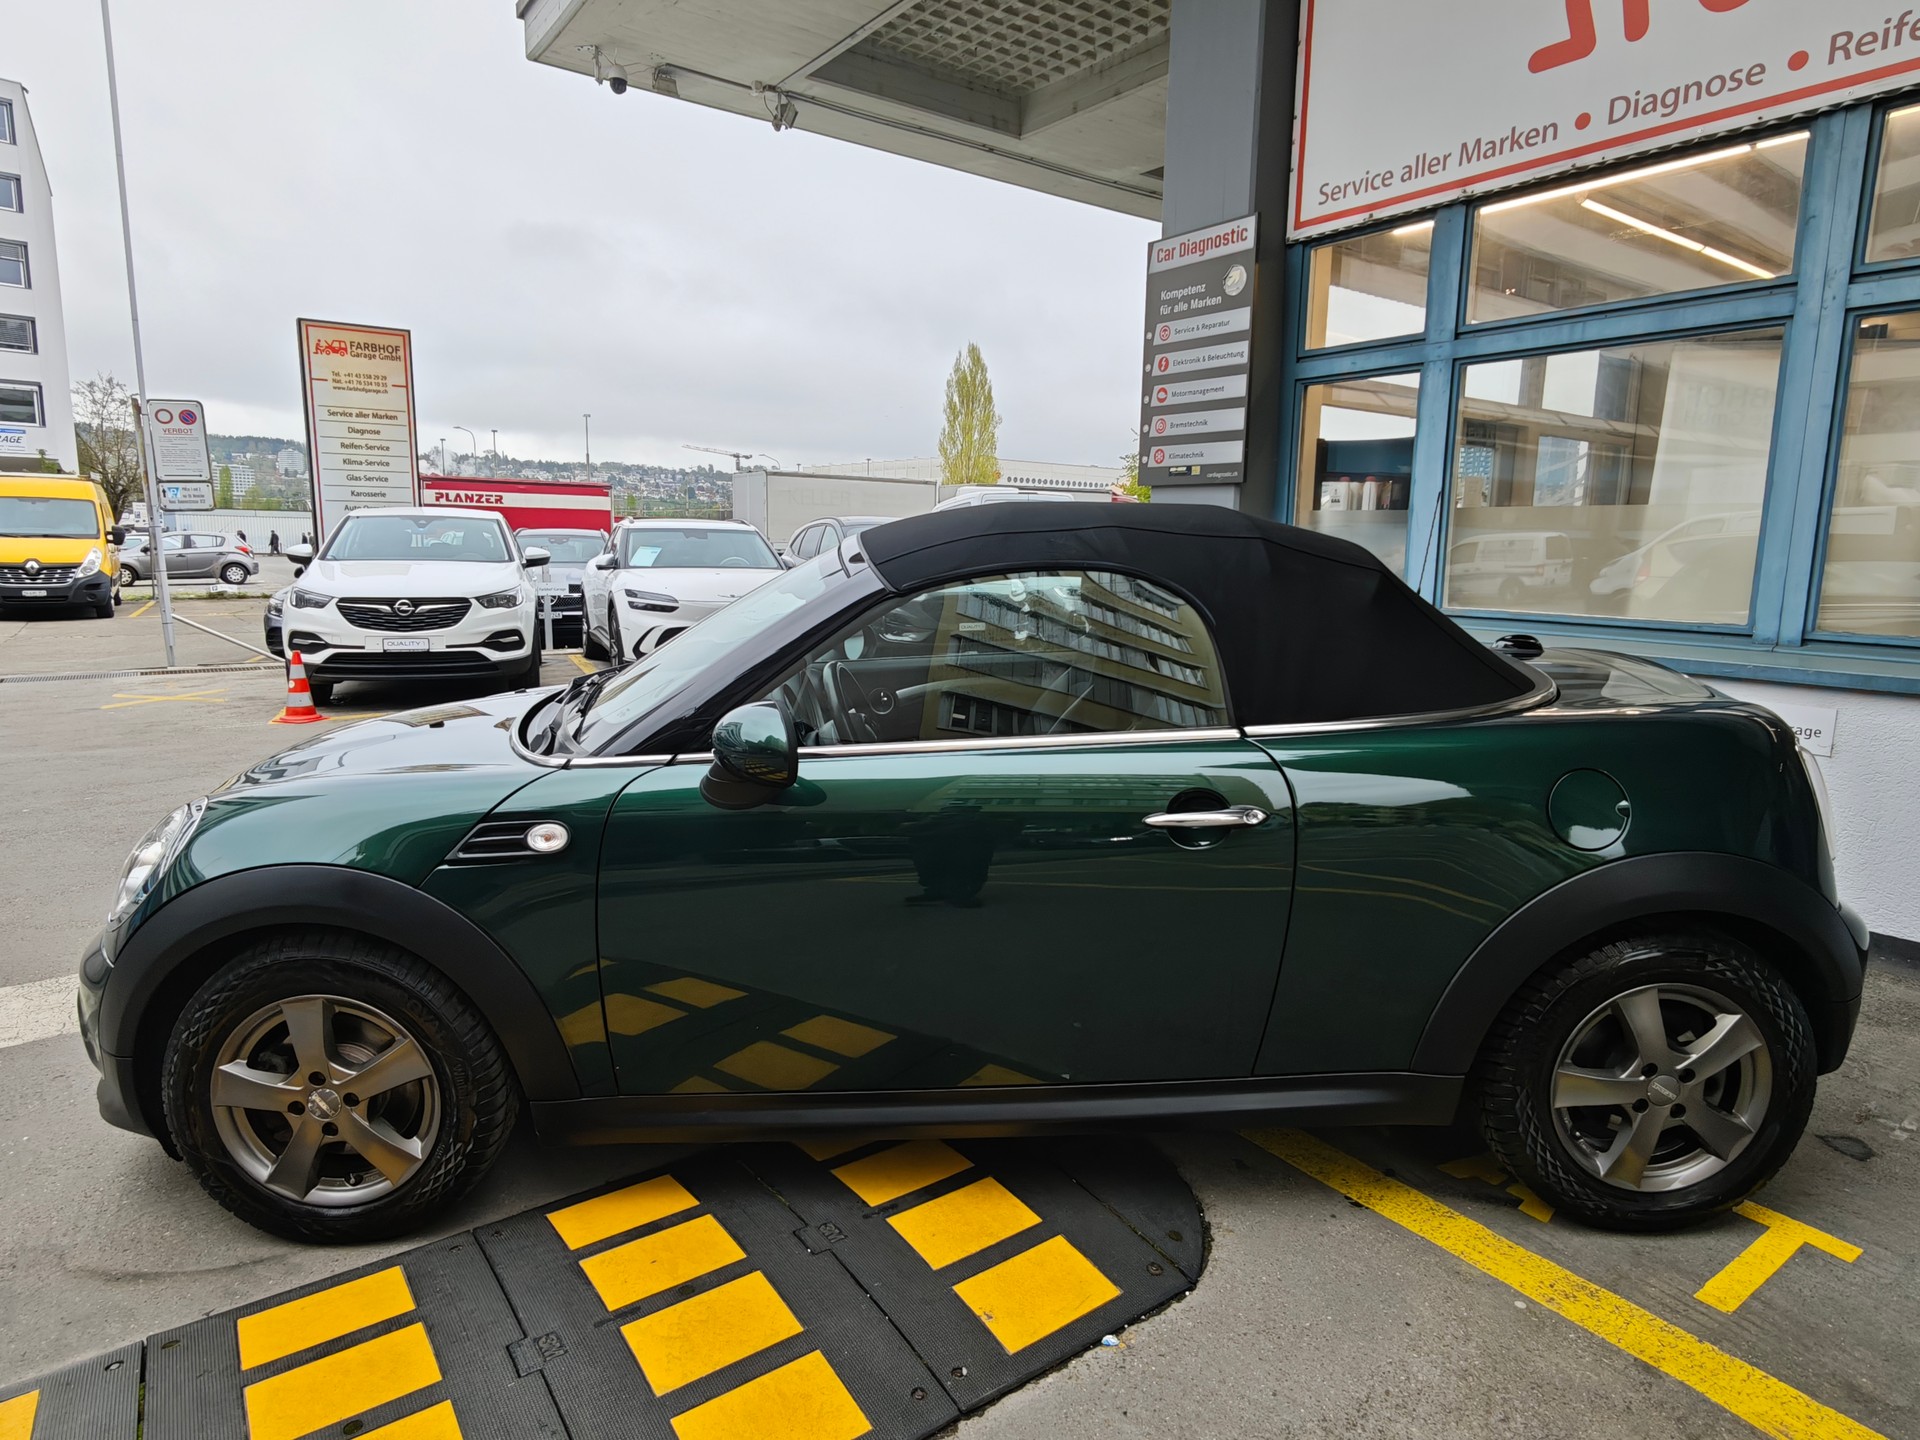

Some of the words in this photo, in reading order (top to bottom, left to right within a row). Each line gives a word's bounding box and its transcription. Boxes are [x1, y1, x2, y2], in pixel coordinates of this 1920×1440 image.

[1607, 63, 1767, 125] Diagnose
[1318, 169, 1394, 206] Service
[1400, 151, 1452, 183] aller
[1458, 121, 1559, 167] Marken
[1156, 246, 1177, 263] Car
[1179, 225, 1248, 257] Diagnostic
[1160, 283, 1206, 301] Kompetenz
[1160, 304, 1171, 315] für
[1173, 301, 1188, 312] alle
[1190, 295, 1222, 309] Marken
[1174, 326, 1195, 335] Service
[1201, 320, 1230, 330] Reparatur
[349, 340, 401, 354] FARBHOF
[349, 351, 377, 360] Garage
[378, 353, 402, 361] GmbH
[1172, 356, 1201, 367] Elektronik
[1207, 351, 1245, 362] Beleuchtung
[332, 385, 388, 394] www.farbhofgarage.ch
[1171, 386, 1224, 398] Motormanagement
[327, 409, 353, 418] Service
[354, 411, 370, 419] aller
[371, 412, 398, 420] Marken
[1169, 419, 1208, 429] Bremstechnik
[347, 426, 381, 436] Diagnose
[0, 434, 23, 443] AGE
[340, 442, 390, 452] Reifen-Service
[1168, 451, 1204, 460] Klimatechnik
[342, 458, 390, 467] Klima-Service
[346, 474, 389, 482] Glas-Service
[350, 490, 387, 498] Karosserie
[435, 492, 504, 504] PLANZER
[1791, 726, 1822, 740] age
[537, 1335, 566, 1361] 3M
